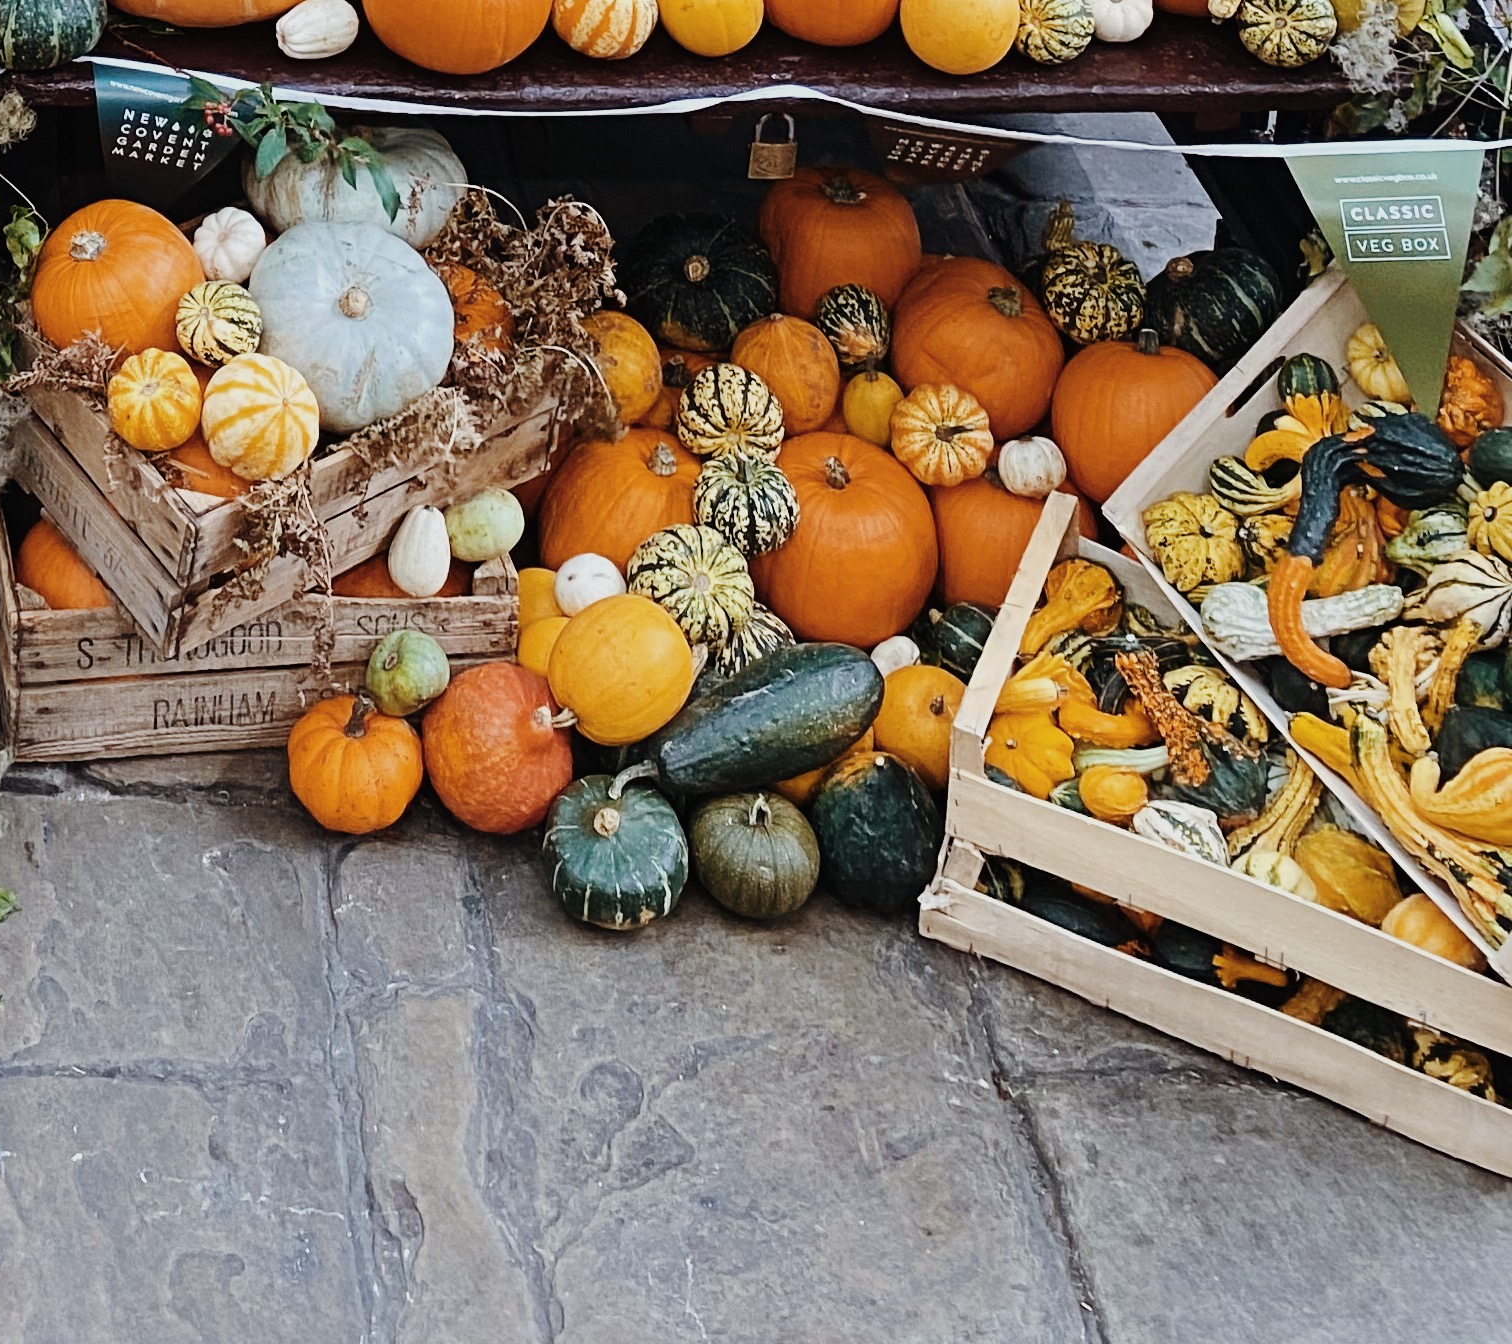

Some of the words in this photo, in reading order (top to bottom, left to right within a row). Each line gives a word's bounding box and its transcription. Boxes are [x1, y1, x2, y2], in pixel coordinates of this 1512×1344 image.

[123, 108, 169, 129] NEW
[116, 136, 206, 162] GARDEN
[120, 123, 209, 151] COVENT
[111, 146, 202, 171] MARKET
[1350, 204, 1434, 222] CLASSIC
[1356, 238, 1394, 253] VEG
[1401, 237, 1440, 252] BOX
[151, 690, 277, 731] RAINHAM
